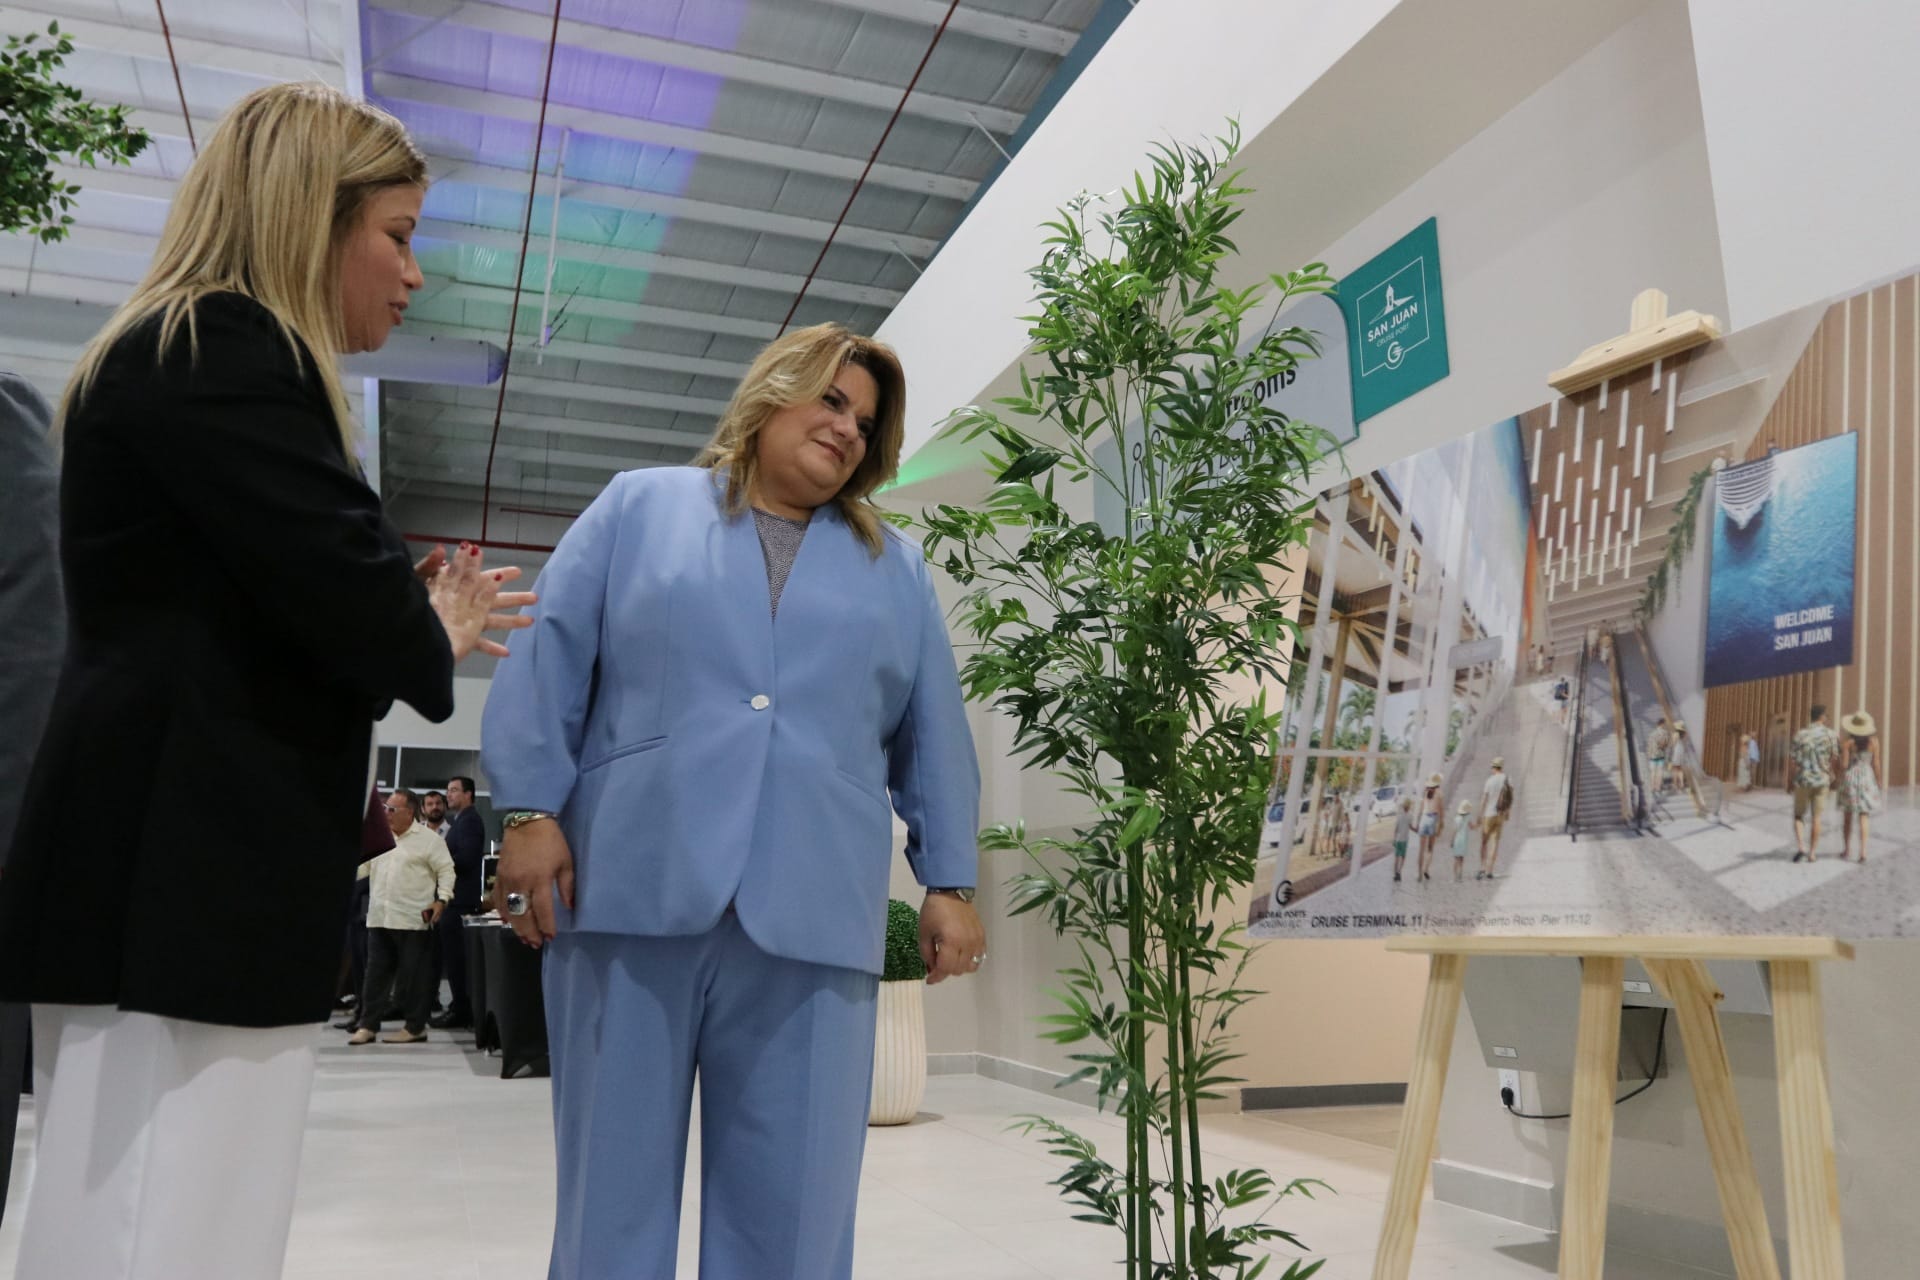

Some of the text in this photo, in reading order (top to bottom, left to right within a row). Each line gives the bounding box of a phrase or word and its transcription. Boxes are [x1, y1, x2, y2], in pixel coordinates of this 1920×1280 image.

[1367, 302, 1418, 342] SAN JUAN
[1774, 604, 1834, 629] WELCOME
[1774, 626, 1832, 650] SAN JUAN
[1311, 915, 1350, 928] CRUISE
[1352, 914, 1407, 928] TERMINAL
[1411, 913, 1423, 926] 11
